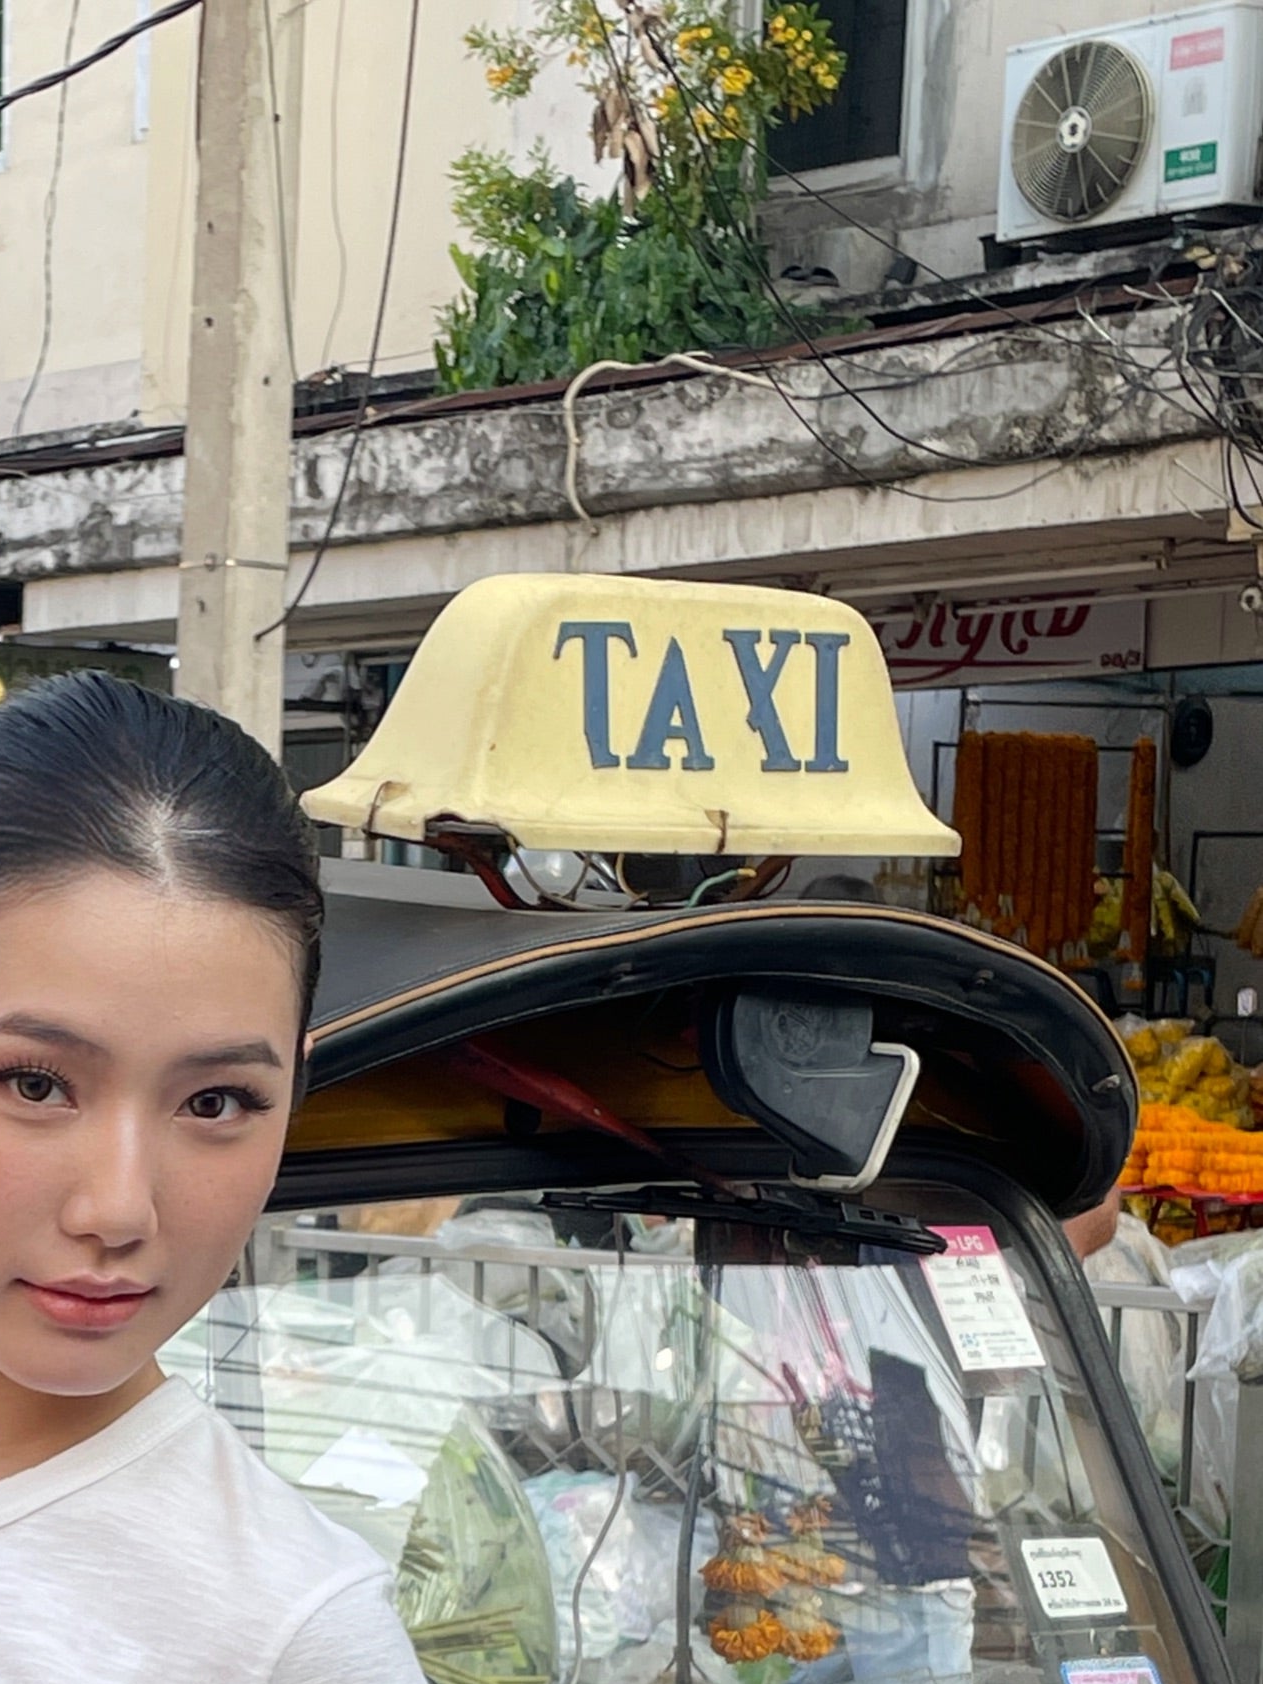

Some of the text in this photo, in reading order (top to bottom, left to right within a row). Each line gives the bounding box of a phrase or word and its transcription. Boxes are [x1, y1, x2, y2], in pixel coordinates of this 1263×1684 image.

[553, 621, 851, 772] TAXI
[956, 1235, 984, 1251] LPG
[1038, 1570, 1076, 1588] 1352
